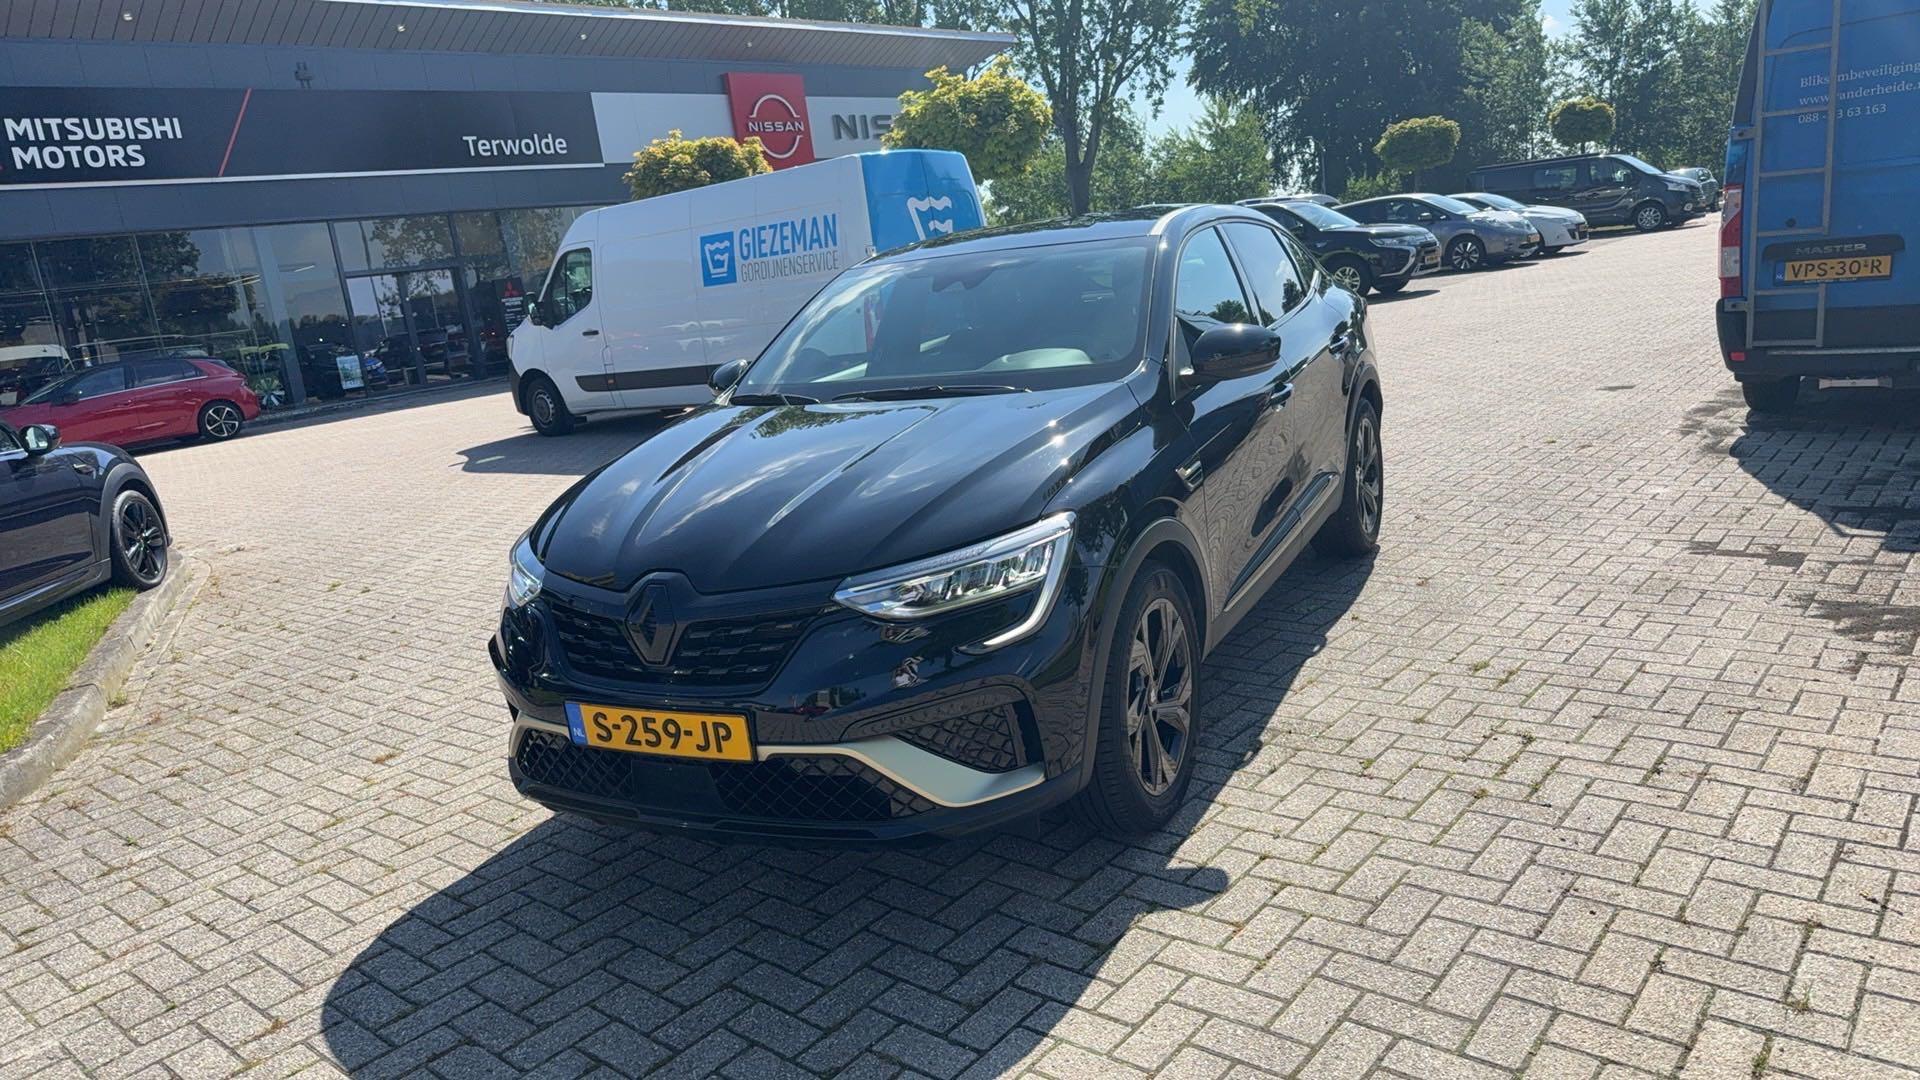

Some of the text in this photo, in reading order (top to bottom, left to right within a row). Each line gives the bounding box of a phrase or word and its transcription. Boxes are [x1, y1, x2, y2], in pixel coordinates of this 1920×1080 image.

[1800, 62, 1920, 88] Bliksmbeveiliging
[1799, 81, 1920, 105] wwwanderheide.
[1798, 112, 1819, 124] 088
[1847, 106, 1861, 118] 63
[1866, 103, 1887, 115] 163
[3, 117, 183, 141] MITSUBISHI
[748, 121, 804, 132] NISSAN
[832, 114, 892, 140] NIS
[11, 144, 146, 169] MOTORS
[462, 133, 568, 156] Terwolde
[738, 213, 838, 261] GIEZEMAN
[1796, 243, 1868, 255] MASTER
[740, 250, 839, 282] GORDIJNENSERVICE
[573, 711, 732, 753] NL S-259-JP
